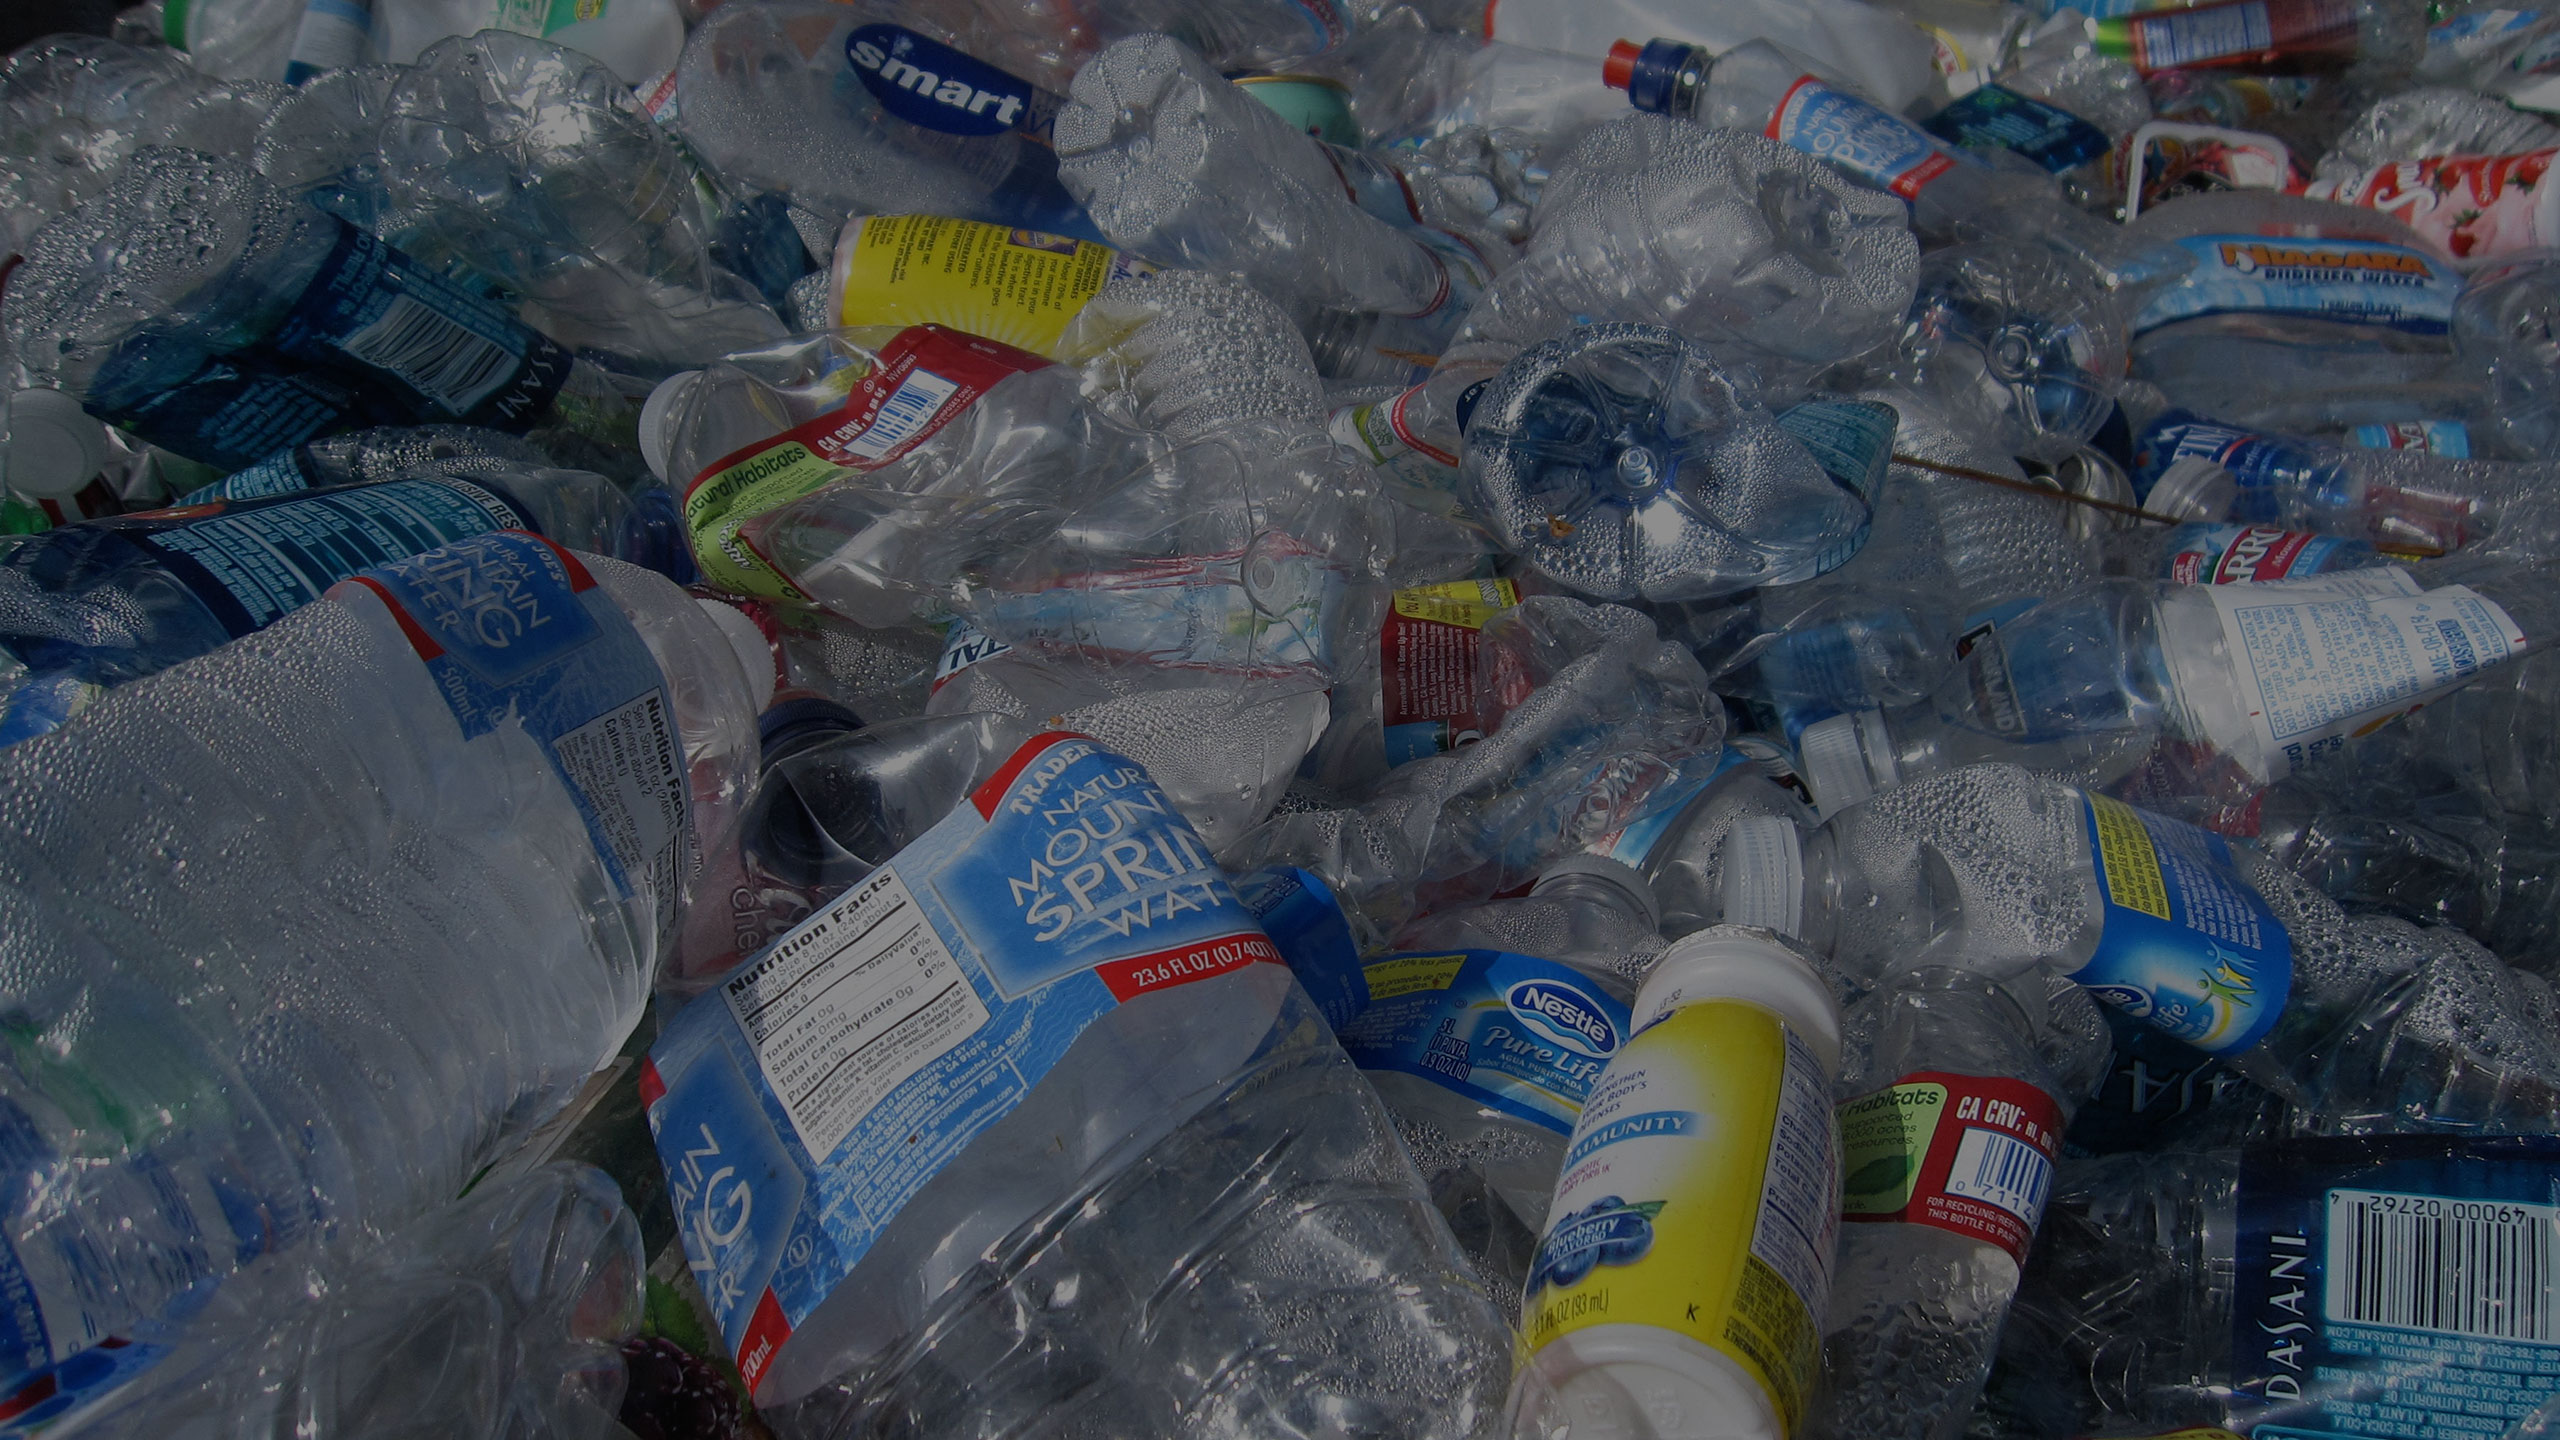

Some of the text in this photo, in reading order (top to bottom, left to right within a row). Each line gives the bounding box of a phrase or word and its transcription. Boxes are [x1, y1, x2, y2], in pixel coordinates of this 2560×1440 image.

[849, 38, 1025, 127] smart
[2217, 242, 2434, 279] NIAGARA
[990, 286, 1001, 307] goes
[1005, 272, 1017, 298] where
[1026, 296, 1036, 314] your
[1041, 274, 1055, 306] immune
[815, 415, 867, 454] CA CRV;
[682, 441, 806, 523] atural Habitats
[530, 543, 566, 583] JOE'S
[436, 662, 483, 723] 500mL
[631, 703, 648, 732] Serv.
[604, 717, 629, 777] Calories 0
[618, 710, 652, 797] Servings about 2
[638, 733, 653, 756] Size
[644, 755, 656, 764] 8
[645, 696, 685, 828] Nutrition Facts
[650, 776, 659, 788] oz
[1009, 739, 1096, 815] TRADER
[1007, 787, 1168, 907] MOUN
[726, 870, 893, 996] Nutrition Facts
[731, 894, 883, 1008] Serving Size 8 fl oz (240mL)
[737, 891, 902, 1017] Servings Per Container about 3
[1131, 949, 1216, 988] 23.6 FL OZ
[745, 959, 836, 1029] Amount Per Serving
[763, 934, 932, 1061] Total Fat 0g 0%
[769, 945, 939, 1074] Sodium 0mg 0%
[751, 992, 809, 1042] Calories 0
[777, 957, 947, 1088] Total Carbohydrate 0g 0%
[856, 1042, 880, 1063] source
[895, 1009, 931, 1036] calories
[930, 994, 952, 1013] from
[845, 1084, 870, 1109] Daily
[868, 1061, 901, 1087] Values
[902, 1047, 921, 1063] are
[920, 1026, 953, 1051] based
[952, 1018, 966, 1030] on
[1480, 1023, 1557, 1065] Pure
[785, 1045, 849, 1103] Protein 0g
[828, 1025, 934, 1109] vitamin vitamin calcium
[1498, 1049, 1584, 1093] AGUA PURIFICADA
[842, 1093, 875, 1125] calorie
[1877, 1124, 1917, 1134] acres
[1954, 1094, 1982, 1121] CA
[1984, 1097, 2026, 1131] CRV;
[1925, 1195, 1944, 1207] FOR
[1927, 1207, 1949, 1220] THIS
[1949, 1212, 1984, 1230] BOTTLE
[1985, 1222, 1995, 1234] IS
[2330, 1192, 2526, 1224] 49000 02762 4
[1545, 1217, 1619, 1255] Blueberry
[1555, 1298, 1571, 1323] OZ
[1682, 1300, 1704, 1325] K
[2256, 1233, 2316, 1402] DASANI
